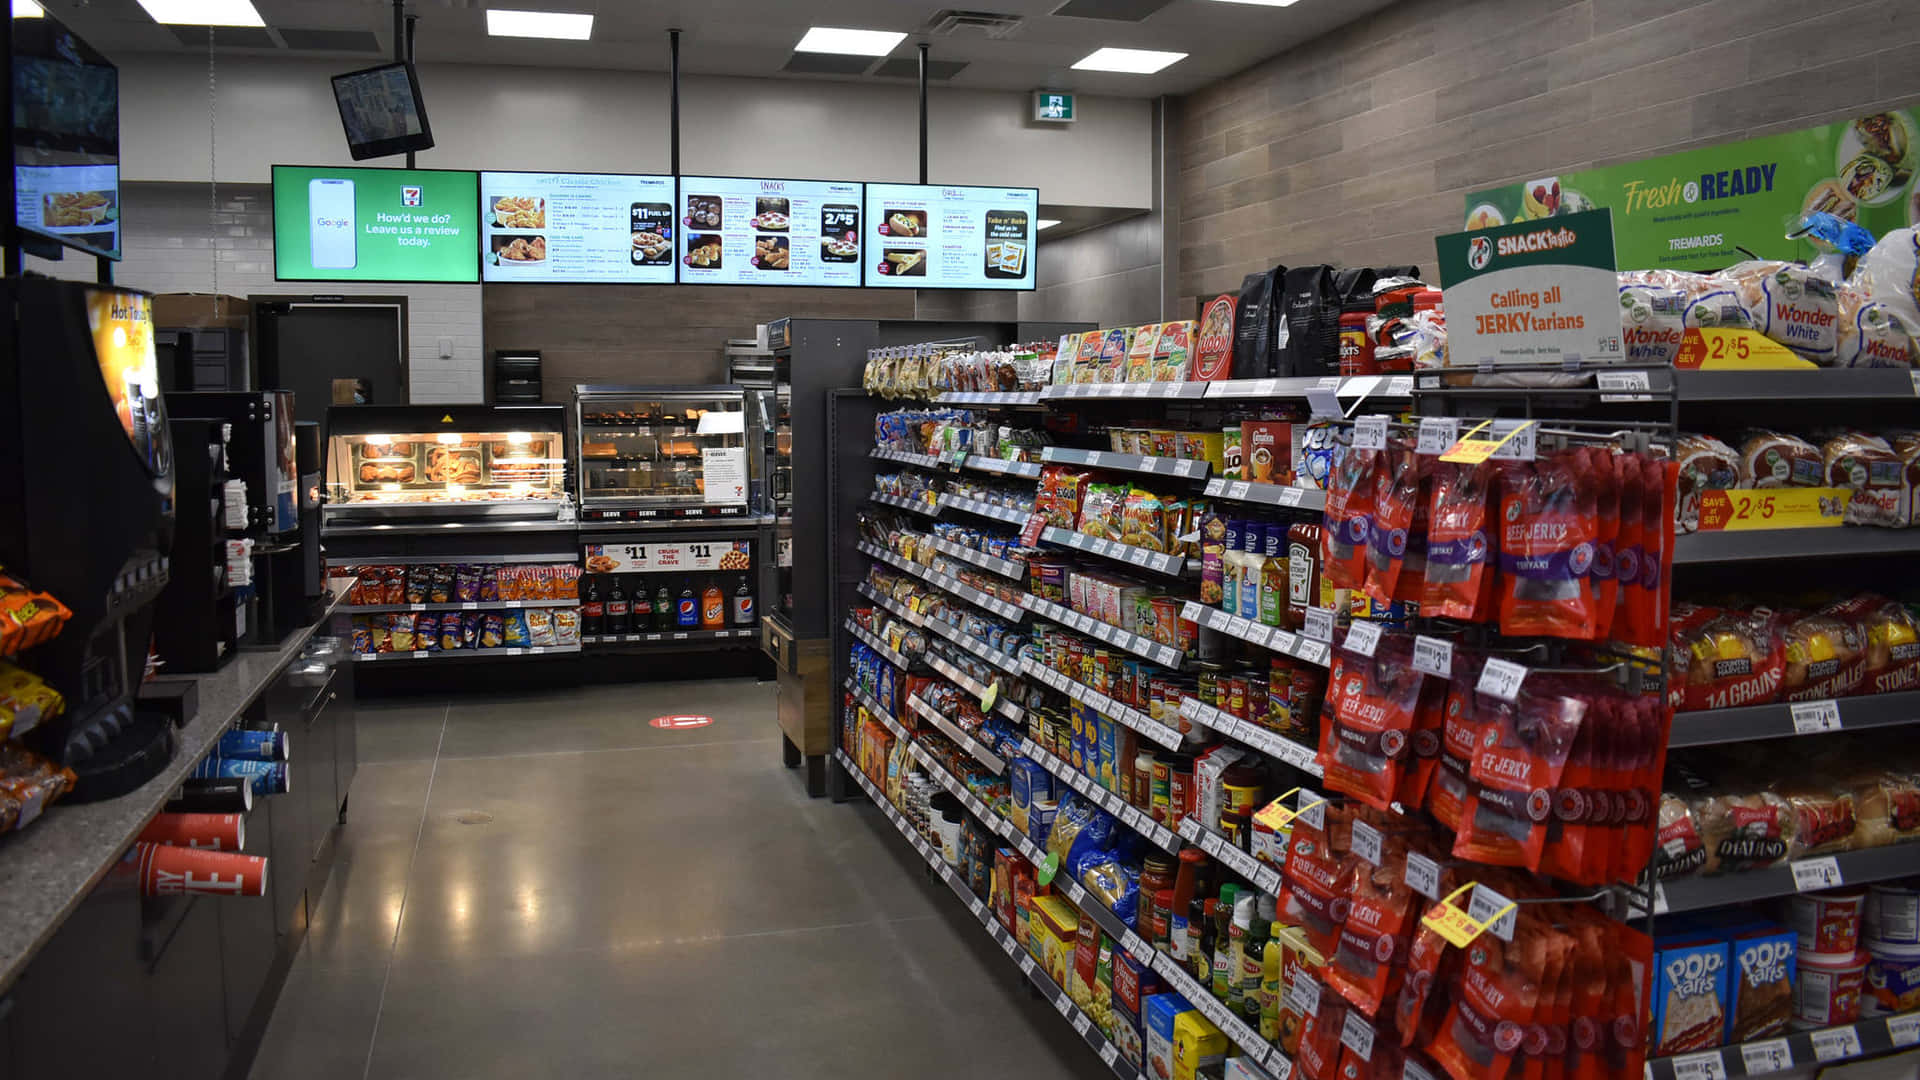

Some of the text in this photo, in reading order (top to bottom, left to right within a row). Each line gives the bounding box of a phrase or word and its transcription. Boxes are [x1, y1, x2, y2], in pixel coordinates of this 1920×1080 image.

[760, 181, 785, 191] SNACKS
[1624, 178, 1681, 214] Fresh
[1701, 163, 1777, 200] READY
[377, 213, 451, 223] How'd we do?
[632, 208, 648, 219] $11
[825, 213, 854, 225] 2/$5
[317, 218, 349, 229] Google
[366, 224, 460, 236] Leave us a review
[398, 236, 431, 248] today.
[1491, 286, 1561, 309] Calling all
[111, 305, 128, 320] Hot
[1777, 303, 1835, 327] Wonder
[1475, 311, 1584, 335] JERKYtarians
[1623, 326, 1682, 344] Wonde
[1786, 324, 1820, 341] White
[1630, 345, 1667, 357] White
[1712, 336, 1750, 360] 2/$5
[1703, 498, 1725, 507] SAVE
[1736, 496, 1775, 519] 2/$5
[1704, 516, 1720, 524] SEV
[1506, 523, 1566, 541] BEEF JERKY
[625, 546, 647, 559] $11
[690, 545, 711, 557] $11
[1729, 667, 1782, 707] GRAINS
[1876, 667, 1914, 693] STONE
[1455, 728, 1475, 747] JERK
[1494, 758, 1532, 780] JERKY
[1354, 904, 1382, 927] JERKY
[1115, 957, 1137, 989] Minute
[1749, 963, 1787, 988] tarts
[1121, 983, 1135, 1003] Rice
[1673, 974, 1716, 1000] tarts
